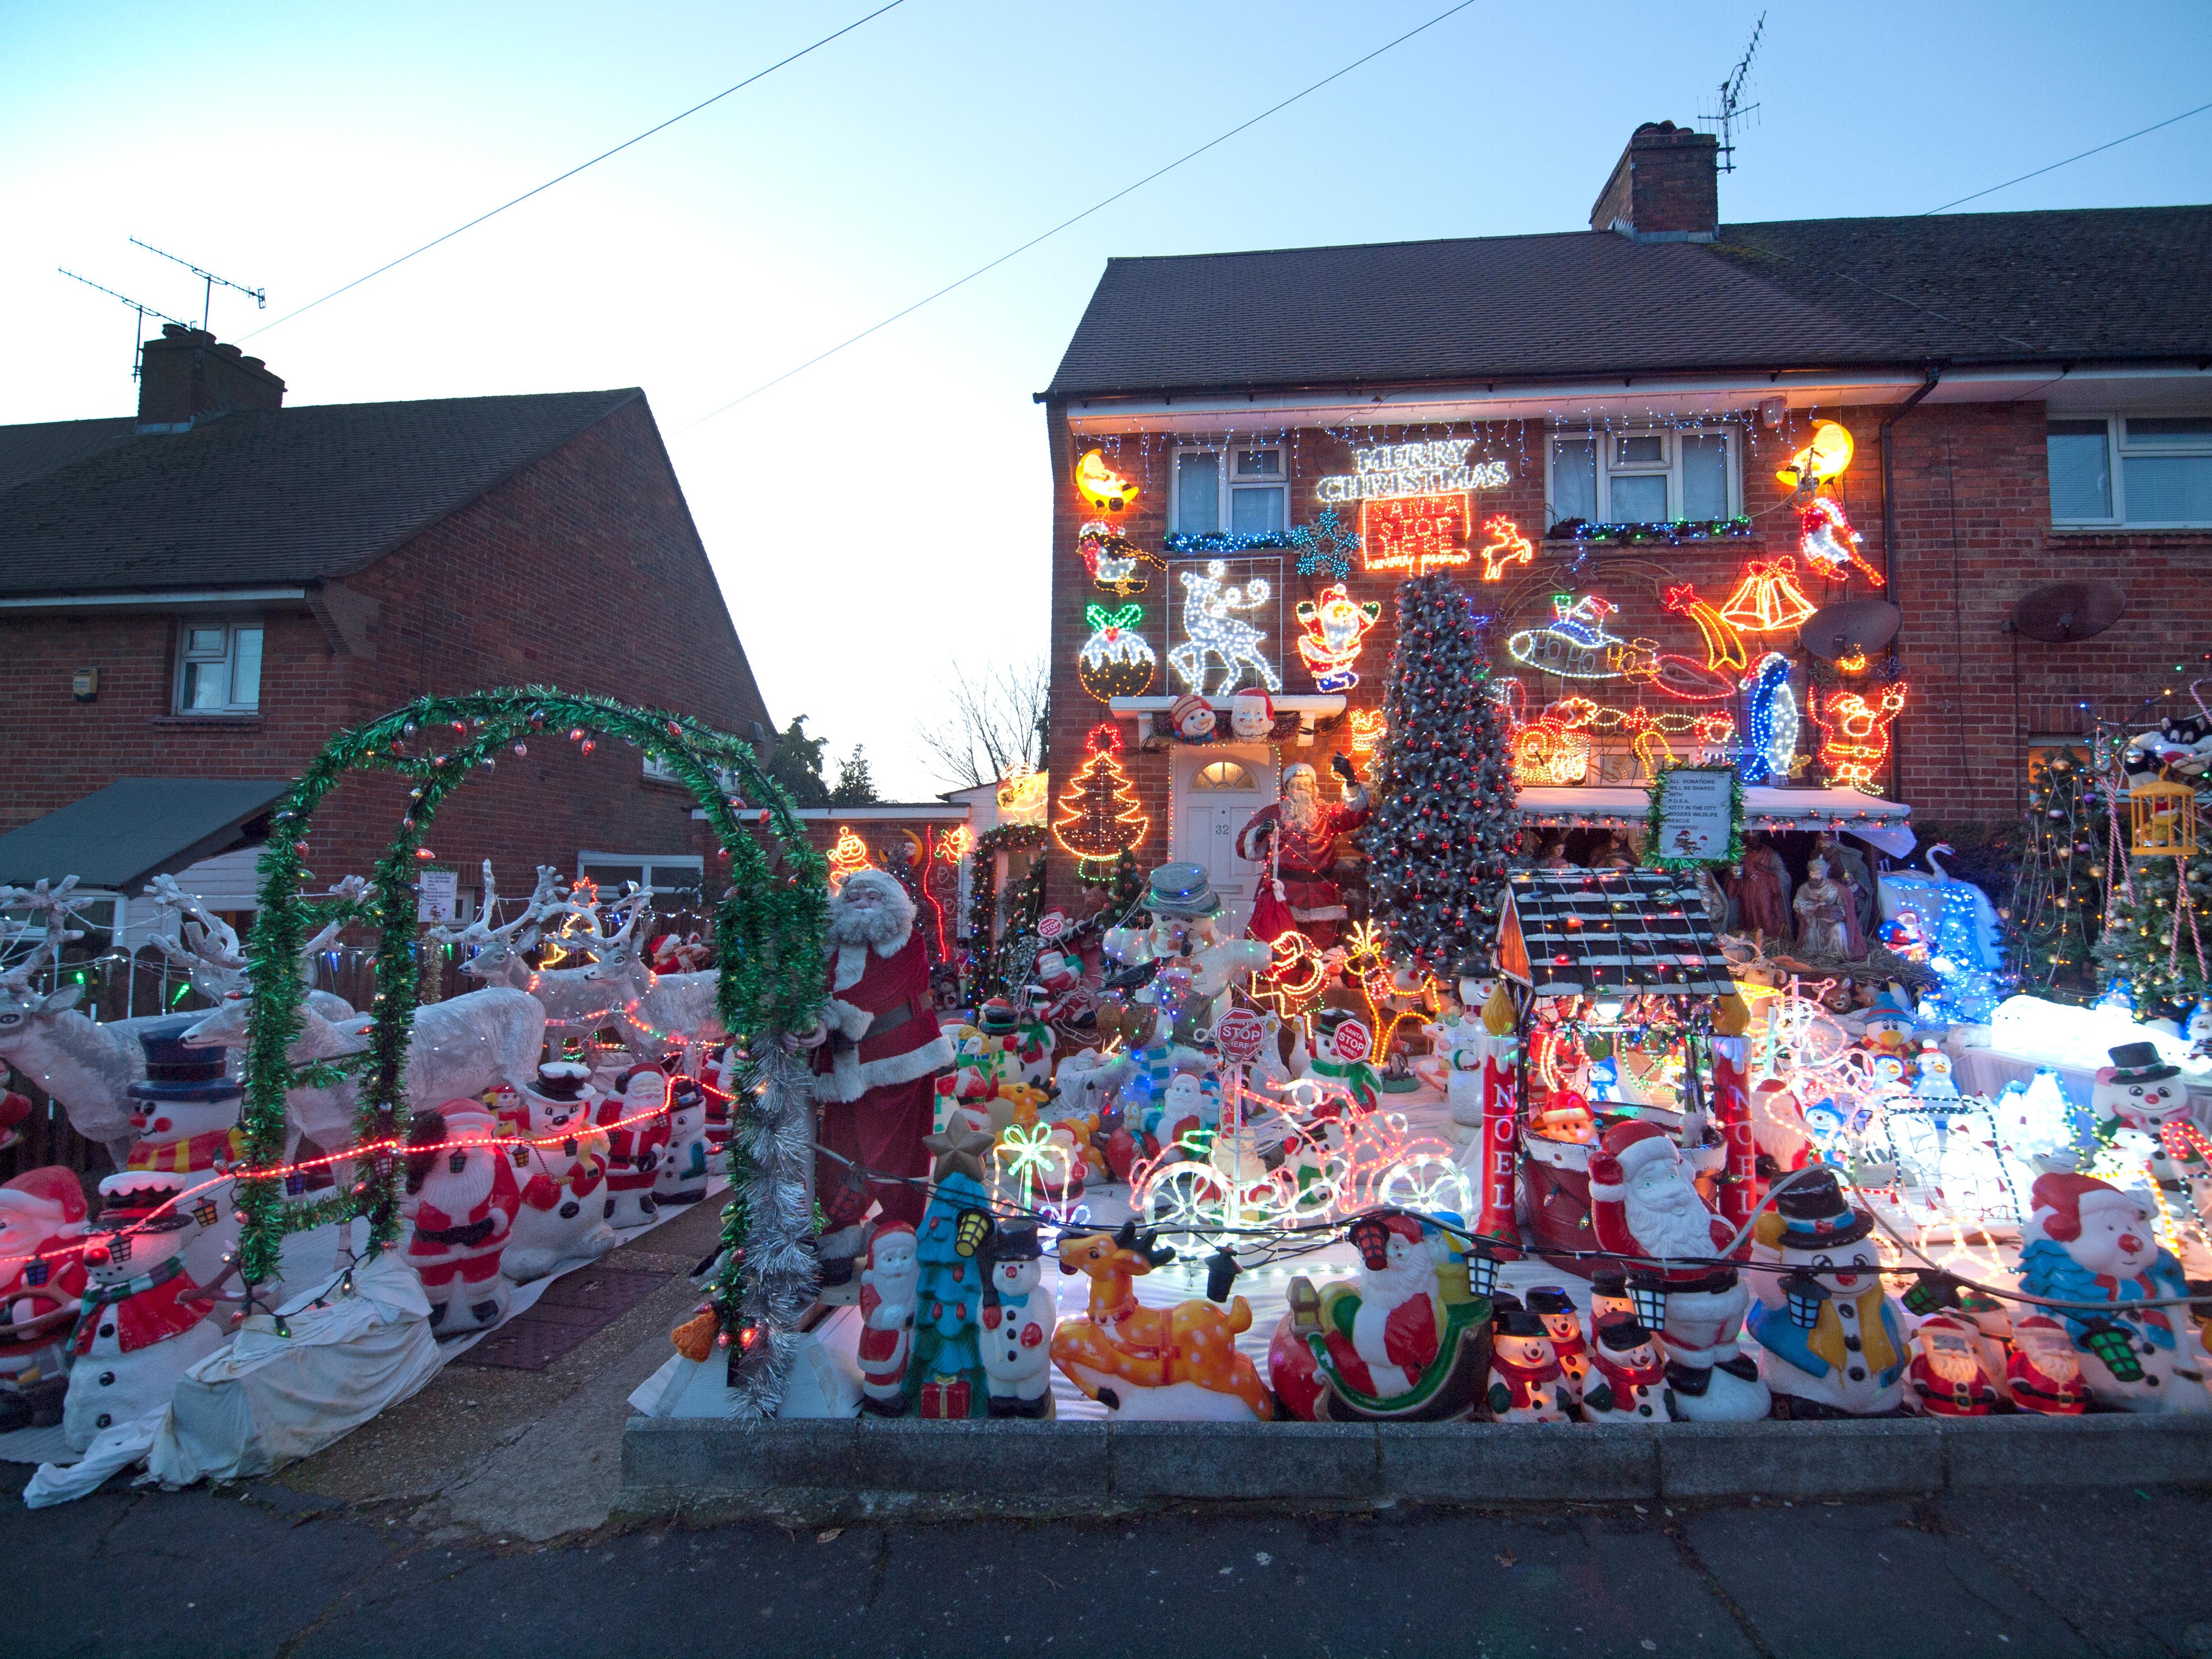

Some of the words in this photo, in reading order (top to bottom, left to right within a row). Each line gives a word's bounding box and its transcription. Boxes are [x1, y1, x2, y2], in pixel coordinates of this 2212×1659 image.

[1356, 439, 1475, 473] MERRY
[1317, 461, 1510, 502] CHRISTMAS
[1374, 497, 1460, 521] SANTA
[1381, 516, 1452, 539] STOP
[1379, 534, 1453, 557] HERE
[1216, 825, 1229, 834] 32
[1042, 922, 1059, 933] STOP
[1222, 1025, 1261, 1041] STOP
[1339, 1032, 1364, 1051] STOP
[1345, 1026, 1363, 1041] SANTA
[1340, 1044, 1358, 1058] HERE!
[1493, 1084, 1515, 1209] NOEL
[1734, 1090, 1754, 1215] NOEL
